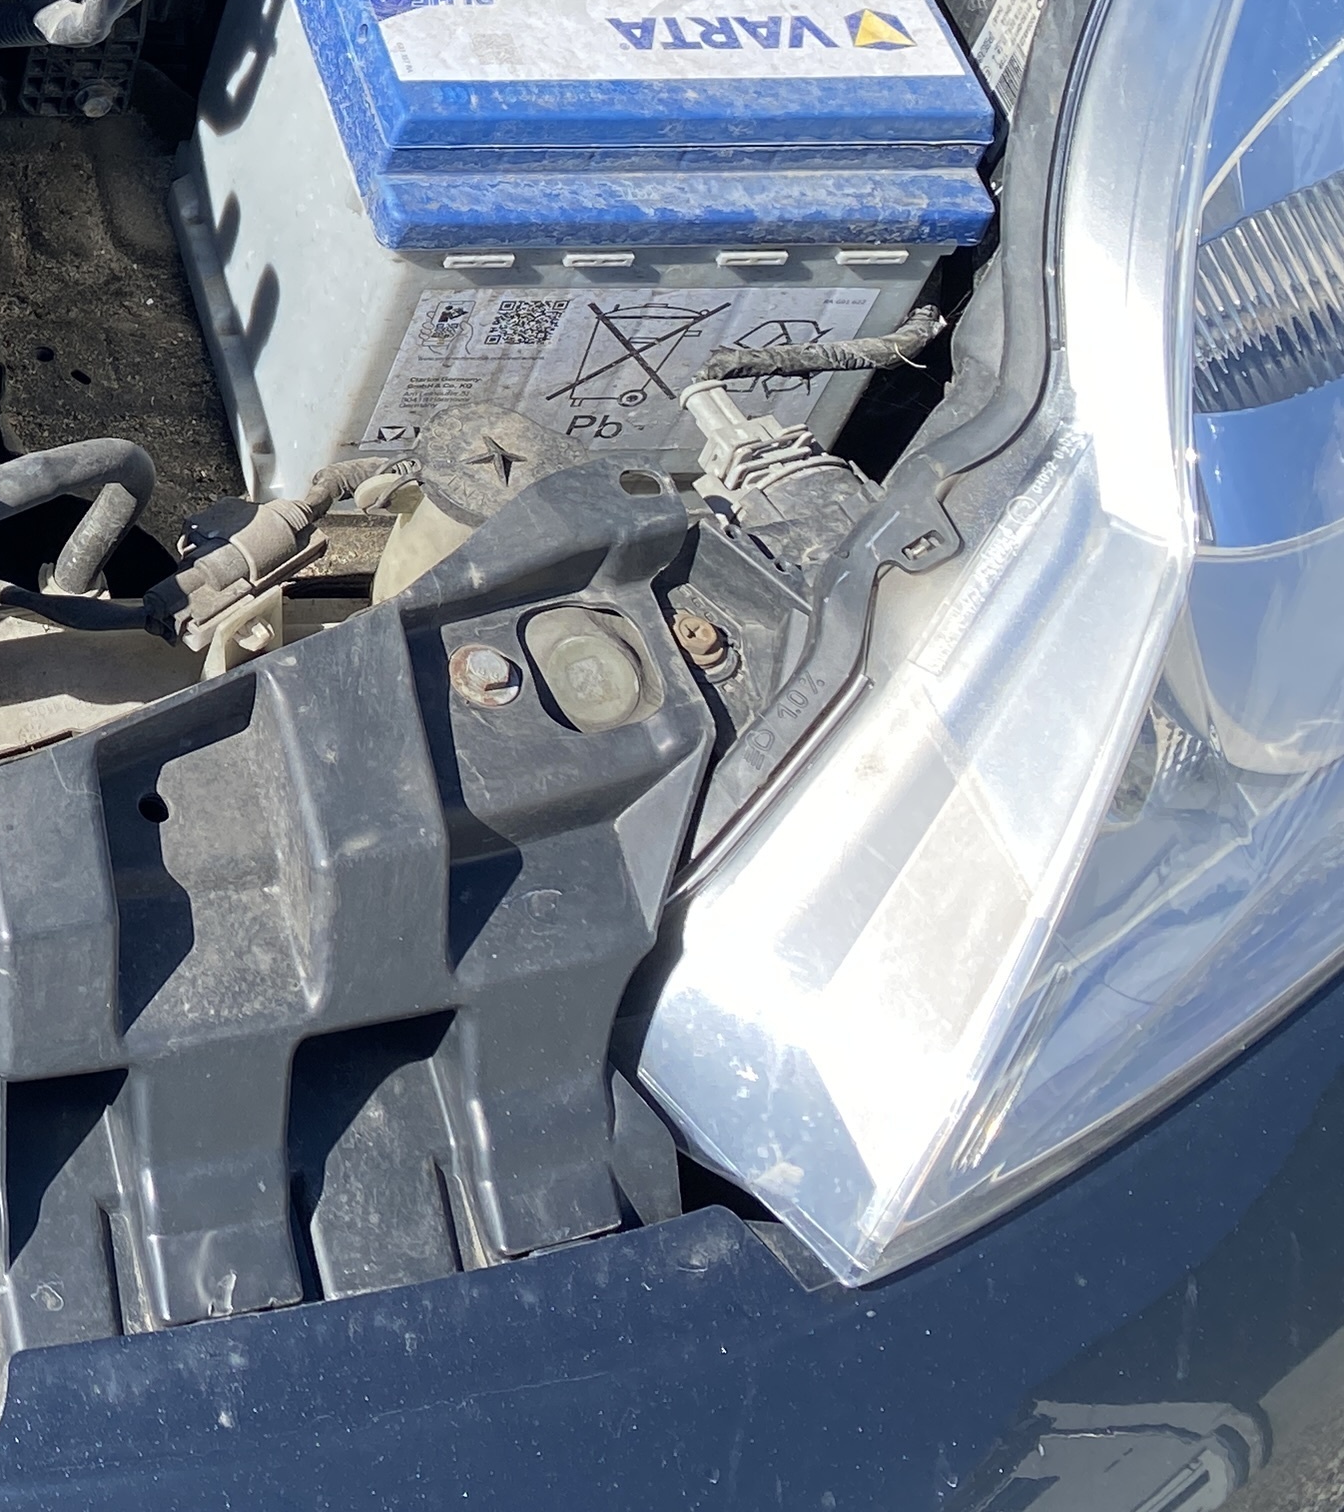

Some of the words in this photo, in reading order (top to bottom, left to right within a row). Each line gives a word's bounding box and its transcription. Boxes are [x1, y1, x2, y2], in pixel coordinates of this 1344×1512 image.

[605, 16, 839, 50] VARTA
[566, 414, 623, 439] Pb
[777, 689, 809, 719] 1.0
[799, 671, 825, 695] %
